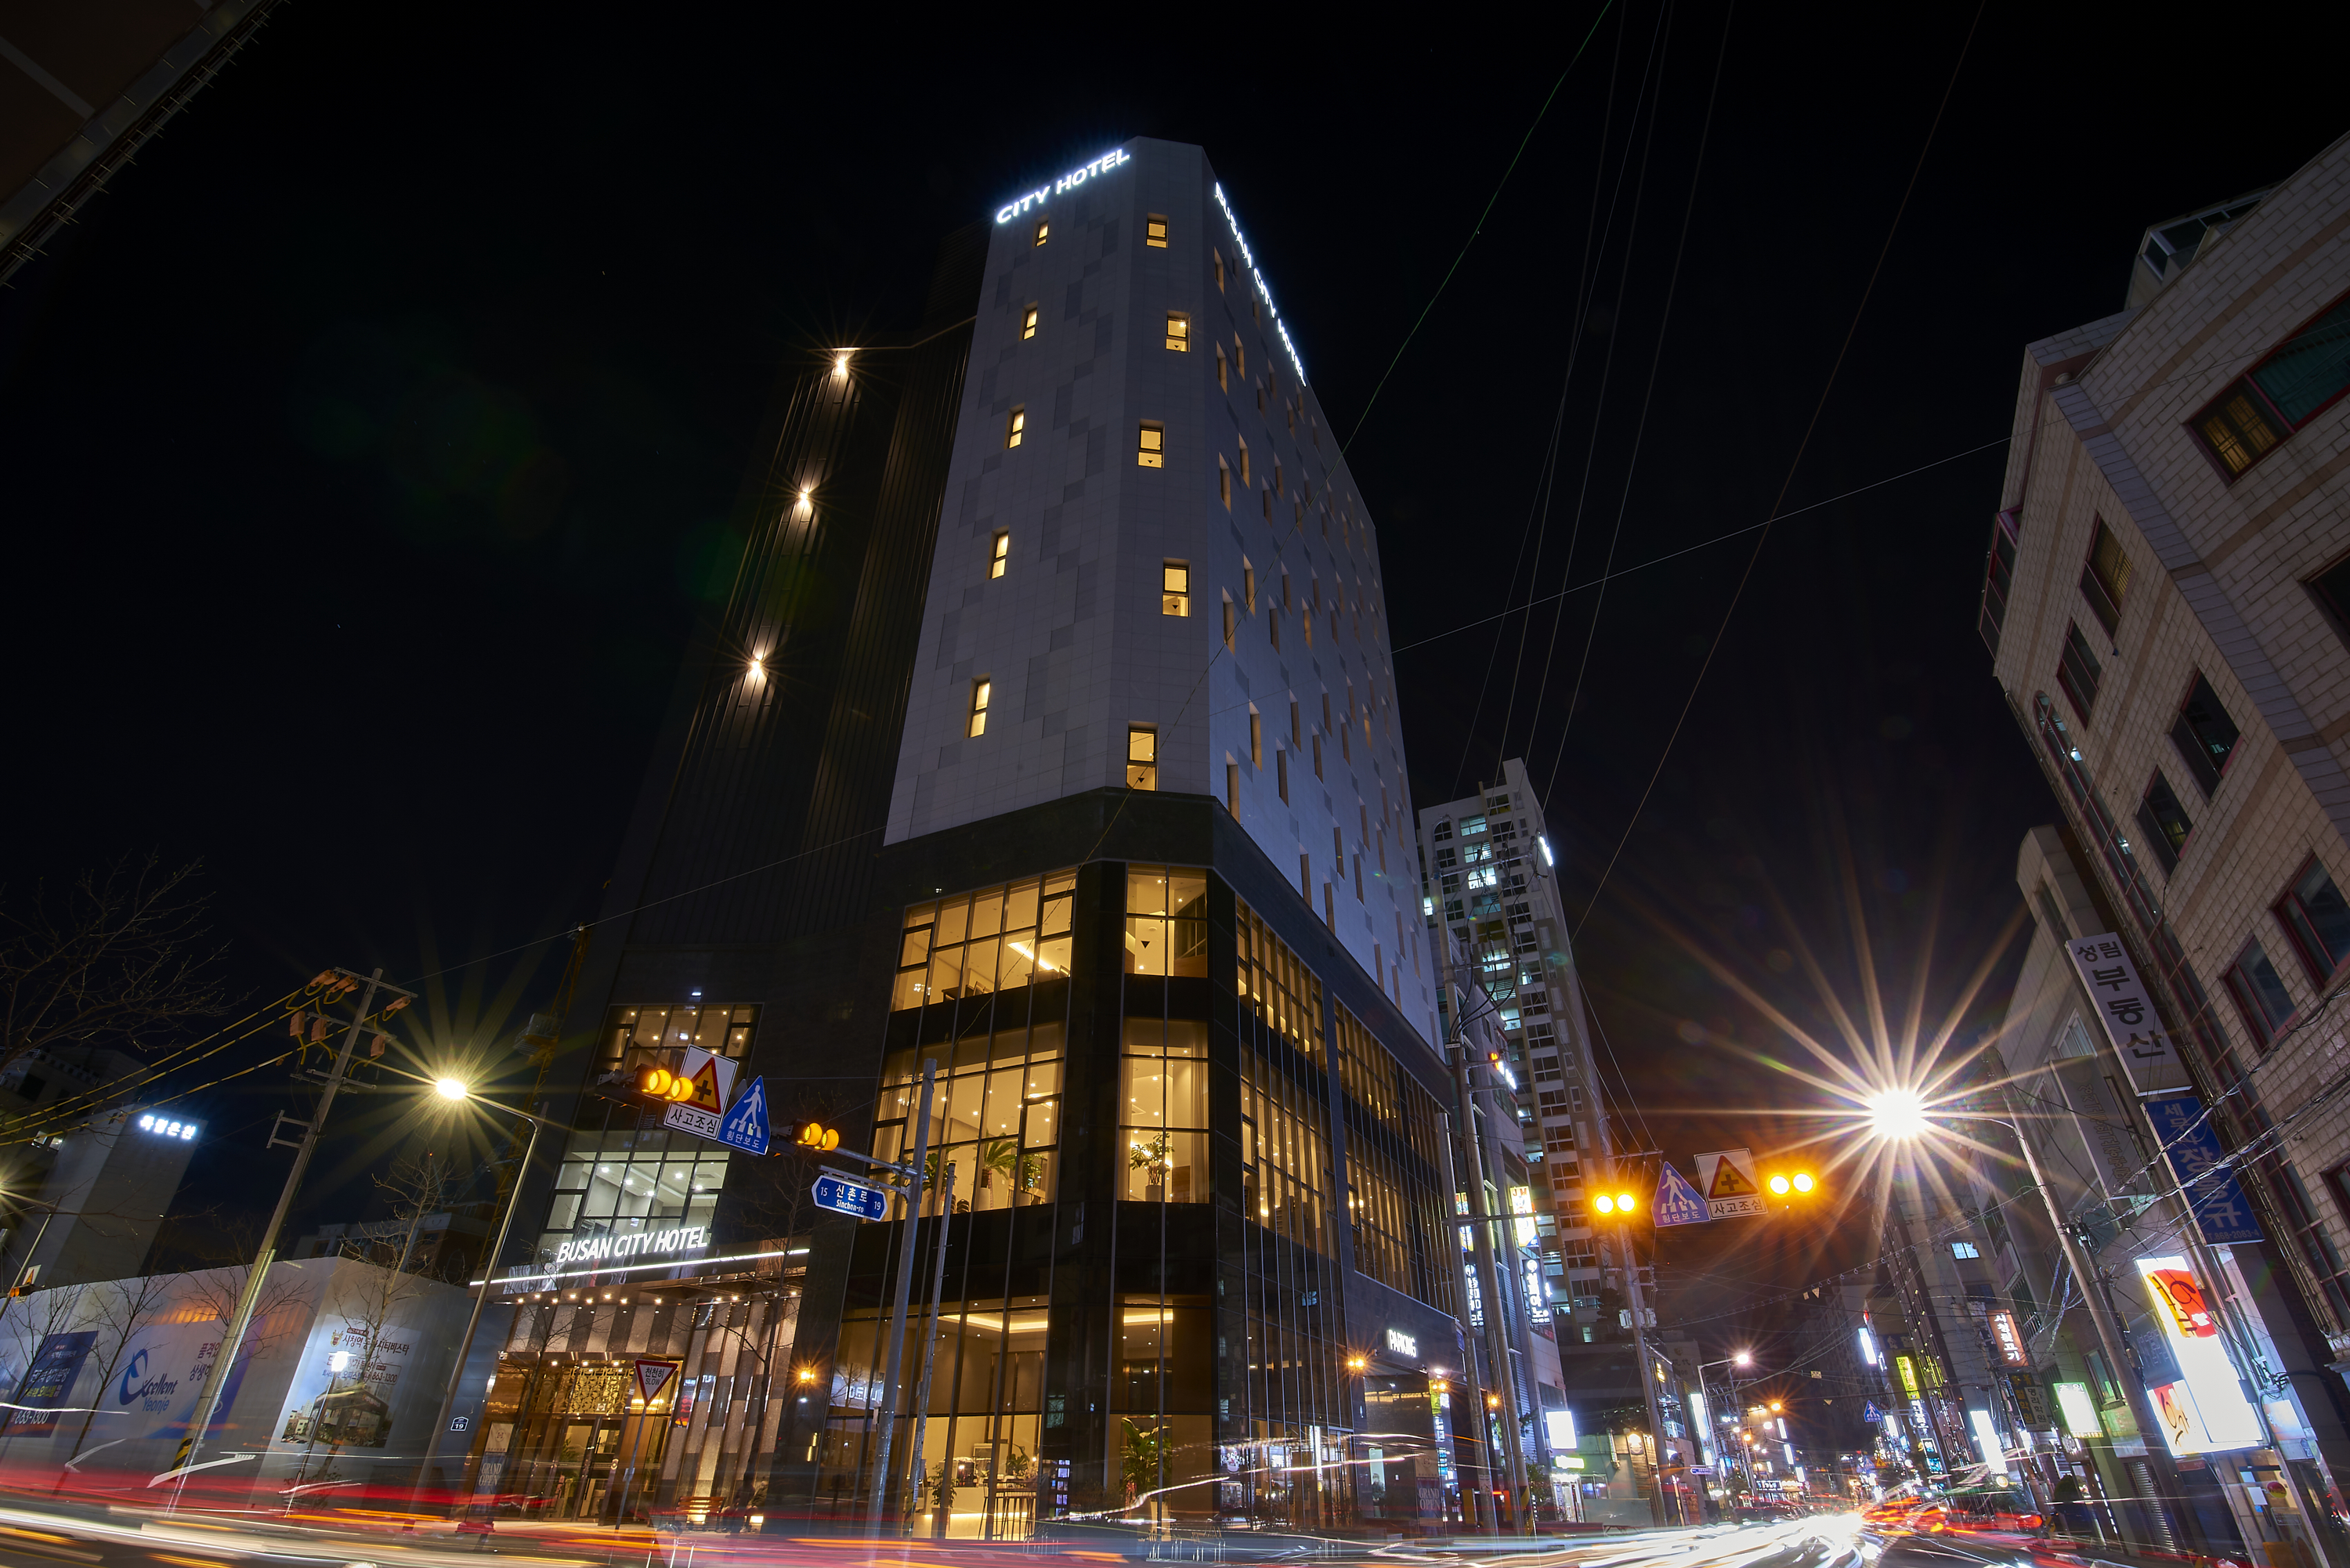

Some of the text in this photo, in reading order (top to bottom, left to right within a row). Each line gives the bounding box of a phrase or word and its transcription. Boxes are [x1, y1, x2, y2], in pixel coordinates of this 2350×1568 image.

[996, 148, 1130, 225] CITY HOTEL
[1214, 181, 1307, 388] BUSAN CITY HOTEL
[2077, 941, 2123, 963] 성림
[2092, 965, 2167, 1059] 부동산
[671, 1108, 718, 1135] 사고조심
[726, 1130, 760, 1149] 횡단보도
[820, 1187, 828, 1197] 15
[836, 1184, 868, 1203] 신촌로
[2177, 1146, 2242, 1228] 장흥규
[836, 1199, 865, 1213] Sinchon-ro
[873, 1201, 881, 1211] 19
[1715, 1198, 1763, 1215] 사고조심
[1661, 1211, 1701, 1223] 횡단보도
[2206, 1229, 2260, 1241] T.868-2083-4
[556, 1226, 708, 1263] BUSAN CITY HOTEL
[342, 1335, 410, 1356] 시청역 동시티비스타
[1388, 1329, 1417, 1358] PARKING
[371, 1371, 398, 1383] 863-1300
[645, 1367, 665, 1379] 천천히
[142, 1396, 170, 1415] Yeonje
[15, 1411, 50, 1425] 863-1300
[481, 1462, 502, 1475] GRAND
[479, 1474, 498, 1487] OPEN
[1419, 1487, 1440, 1499] GRAND
[1419, 1498, 1441, 1511] OPEN
